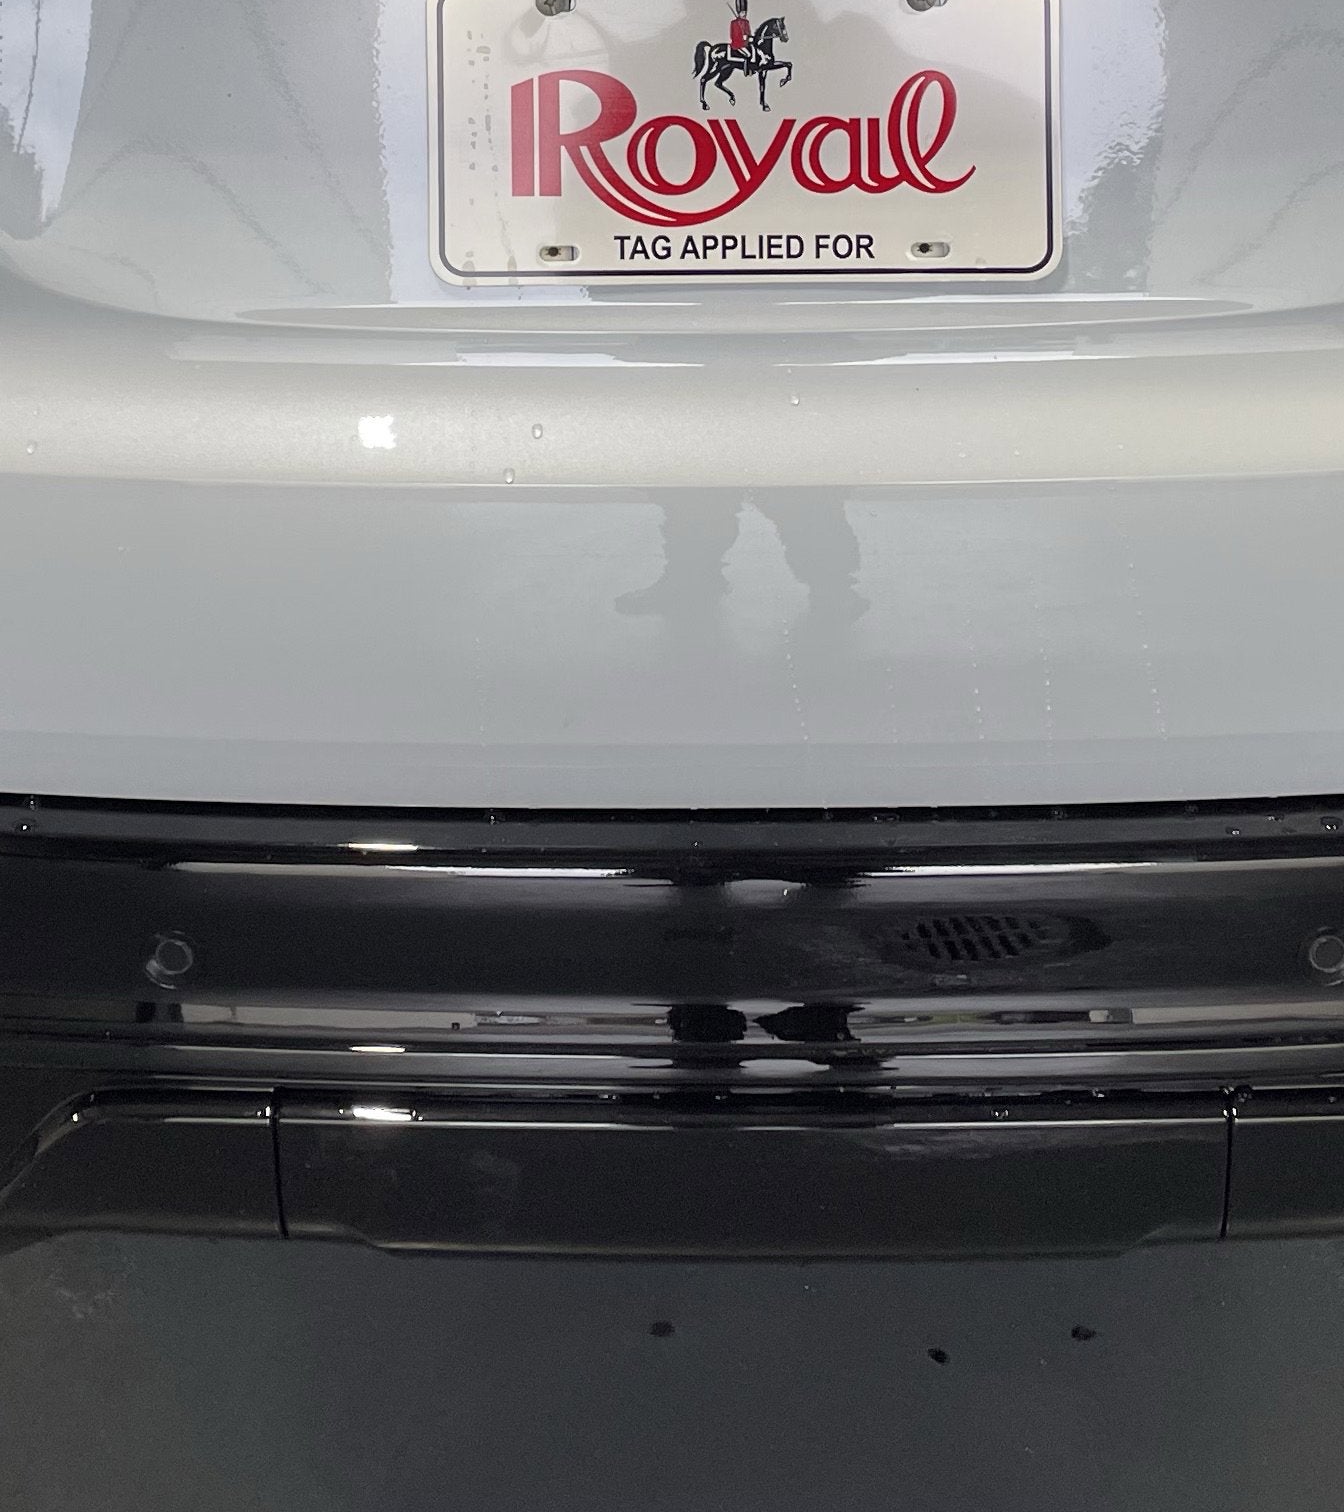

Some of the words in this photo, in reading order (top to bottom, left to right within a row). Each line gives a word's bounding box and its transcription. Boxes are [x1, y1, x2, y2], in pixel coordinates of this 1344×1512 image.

[511, 70, 976, 227] Royal
[614, 236, 672, 260] TAG
[681, 236, 806, 260] APPLIED
[816, 235, 875, 259] FOR
